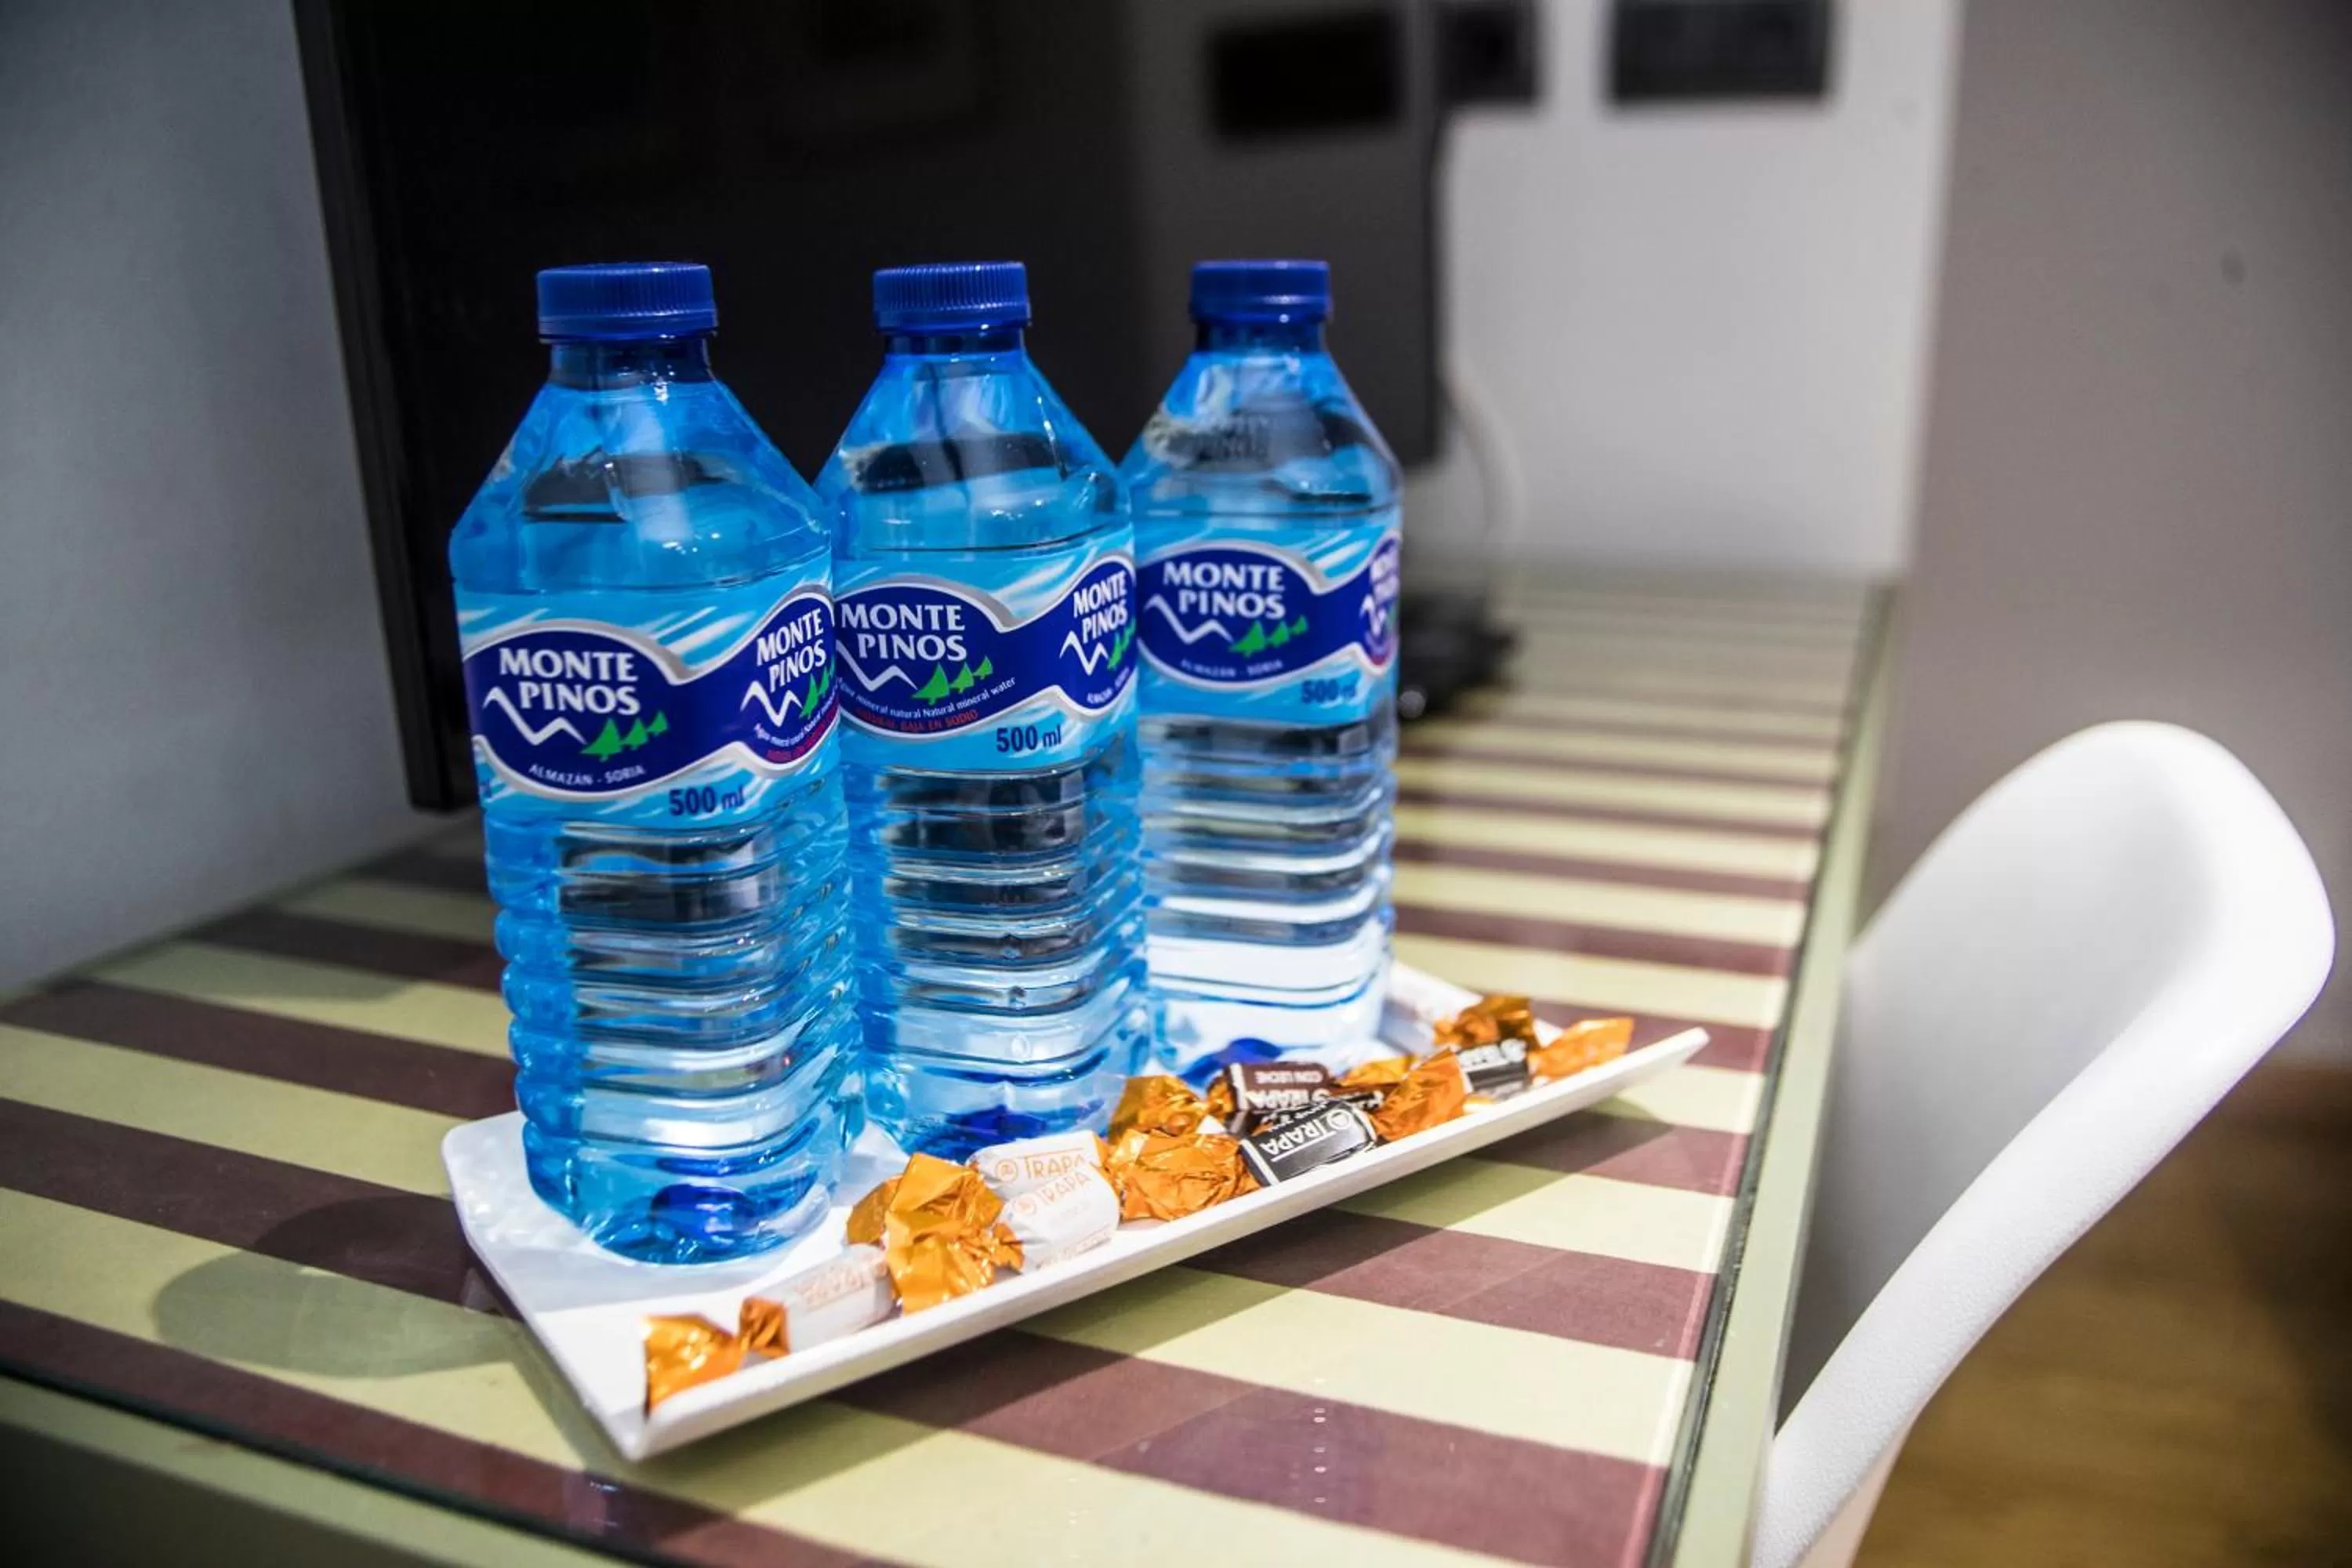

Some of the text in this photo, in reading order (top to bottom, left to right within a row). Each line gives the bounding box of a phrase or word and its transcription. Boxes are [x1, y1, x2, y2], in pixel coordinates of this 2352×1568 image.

[1163, 561, 1285, 592] MONTE
[1073, 569, 1127, 619] MONTE
[1178, 590, 1286, 619] PINOS
[840, 603, 965, 631] MONTE
[1082, 598, 1129, 644] PINOS
[757, 608, 824, 667] MONTE
[857, 633, 967, 662] PINOS
[499, 648, 639, 682] MONTE
[769, 639, 826, 694] PINOS
[518, 681, 641, 716] PINOS
[890, 709, 922, 719] natural
[923, 702, 956, 717] Natural
[956, 689, 989, 710] mineral
[990, 677, 1017, 696] water
[996, 724, 1062, 753] 500 ml
[605, 764, 646, 784] SORIA
[669, 785, 745, 816] 500 ml
[1259, 1118, 1338, 1156] TRAPA
[1022, 1149, 1087, 1179] TRAPA
